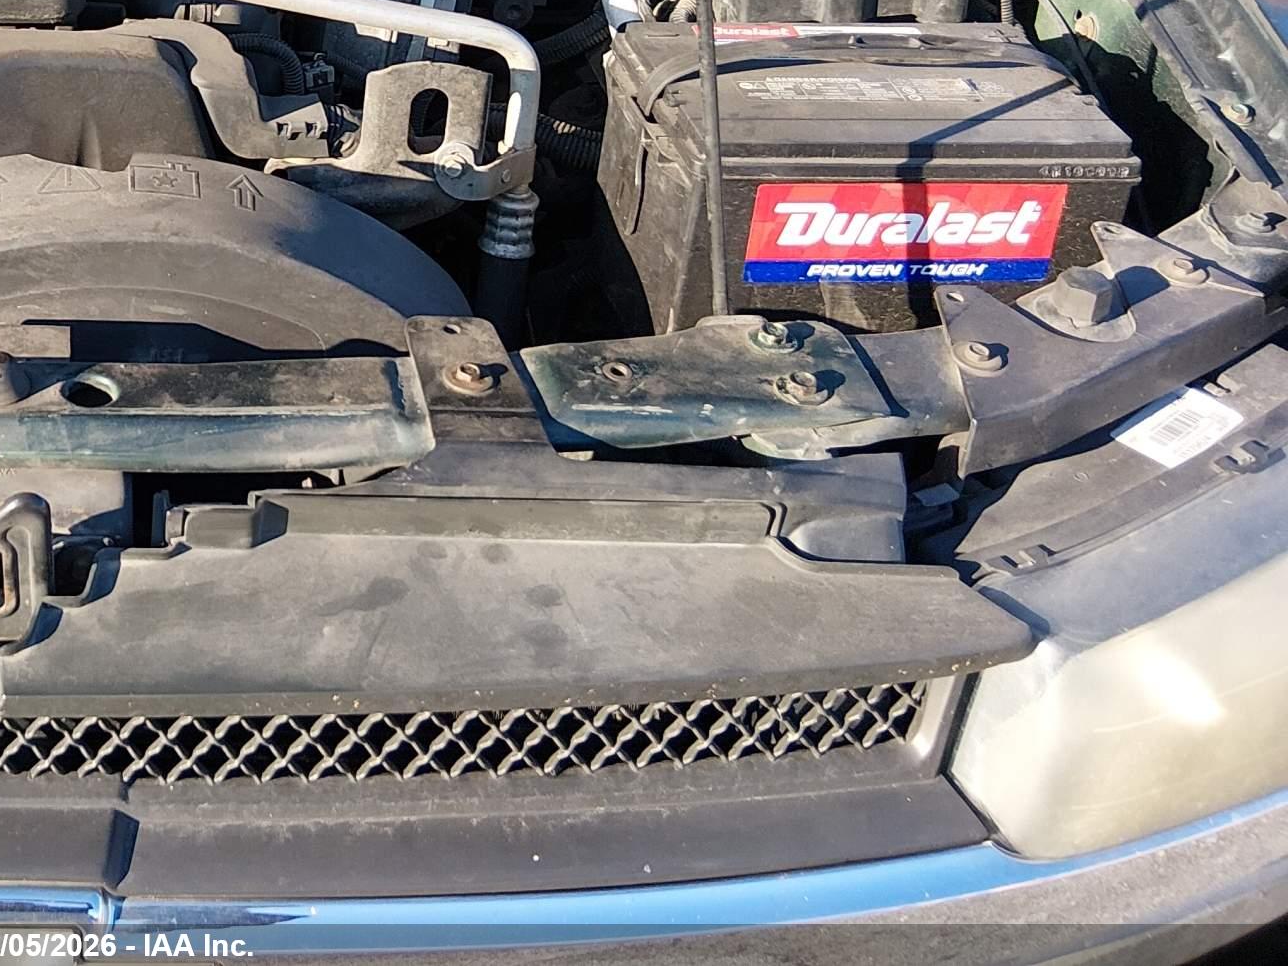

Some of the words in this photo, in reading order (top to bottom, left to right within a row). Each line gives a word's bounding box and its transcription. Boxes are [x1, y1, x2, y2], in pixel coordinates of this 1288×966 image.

[773, 200, 1043, 247] Duralast
[807, 263, 905, 277] PROVEN
[909, 263, 989, 276] TOUGH
